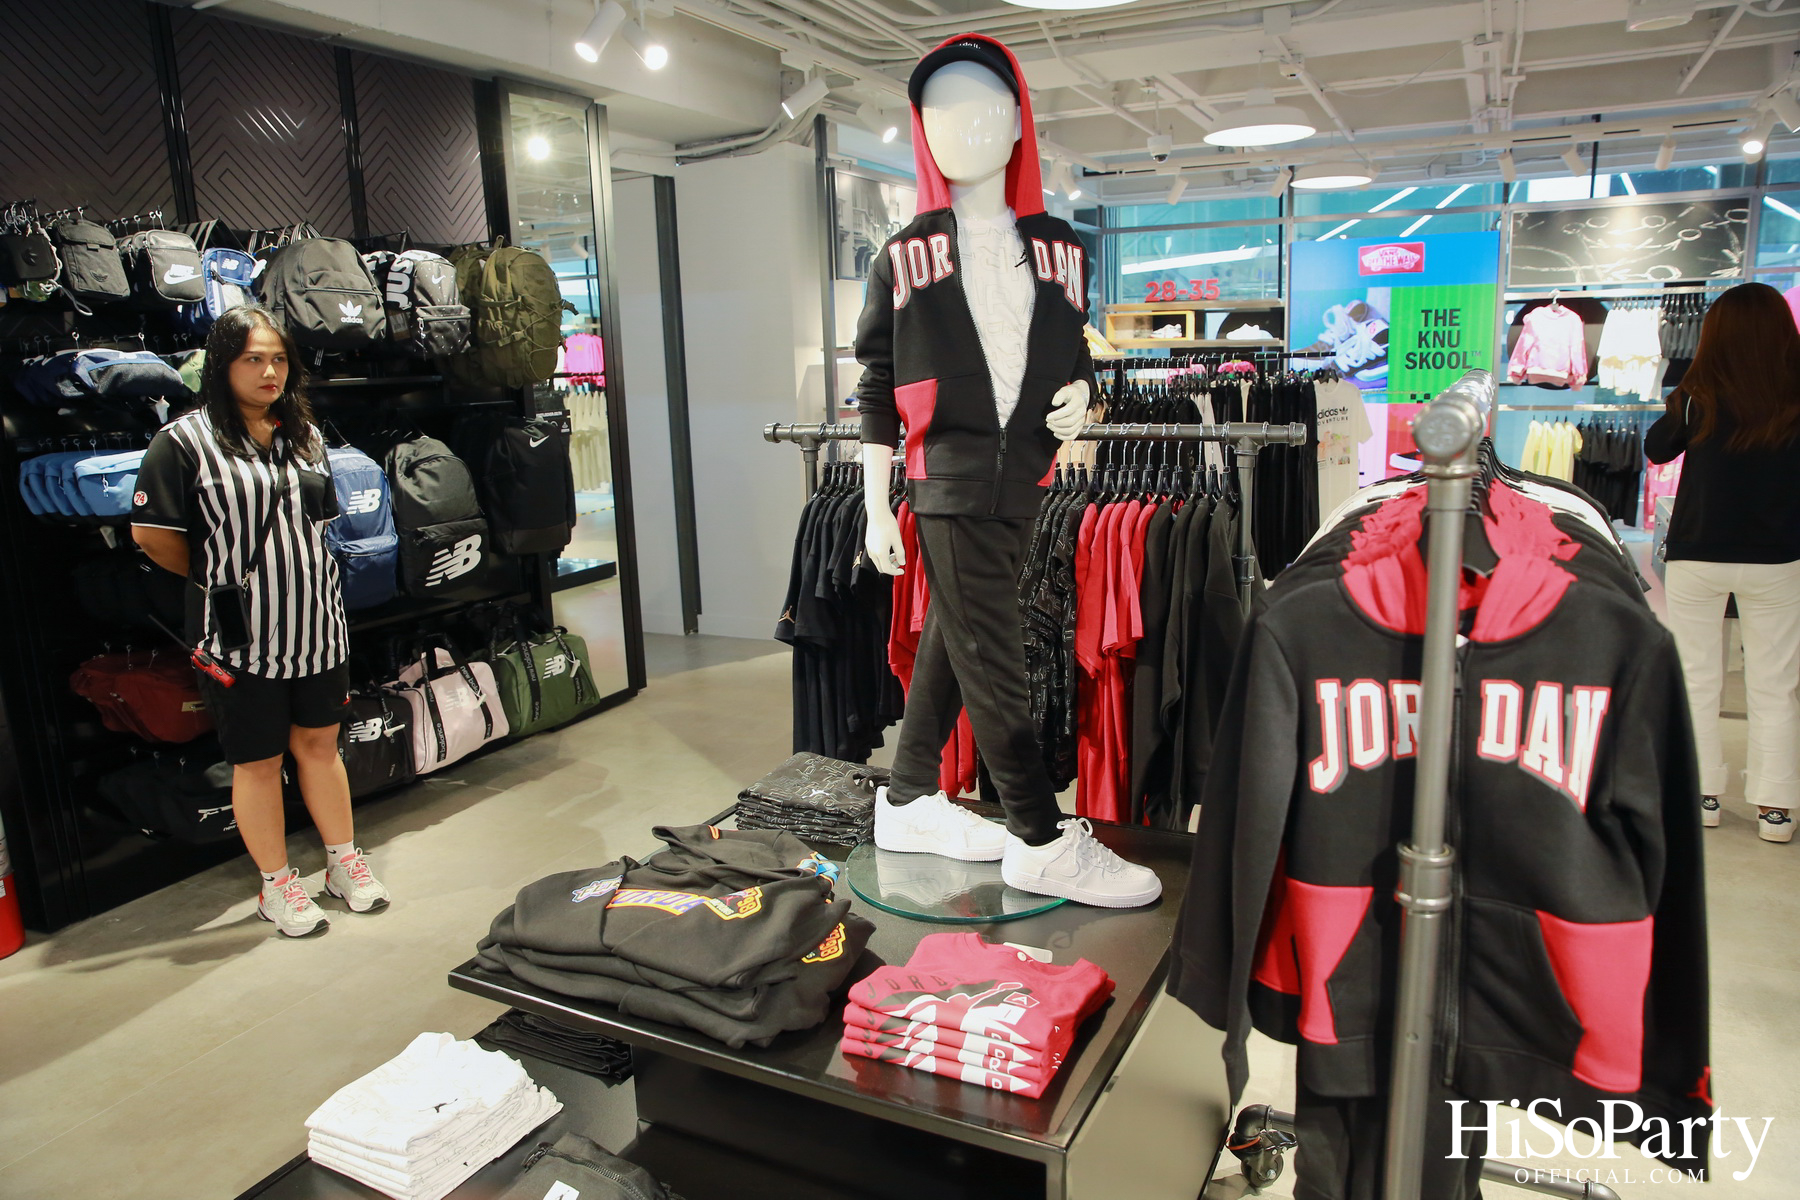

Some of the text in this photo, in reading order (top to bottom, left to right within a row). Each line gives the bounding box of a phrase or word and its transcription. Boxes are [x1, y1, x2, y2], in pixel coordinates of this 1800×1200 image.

[888, 232, 1084, 313] JOR DAN
[1145, 278, 1221, 302] 28-35
[1420, 308, 1462, 328] THE
[1418, 330, 1461, 349] KNU
[1317, 408, 1339, 420] didas
[1476, 680, 1612, 814] DAN
